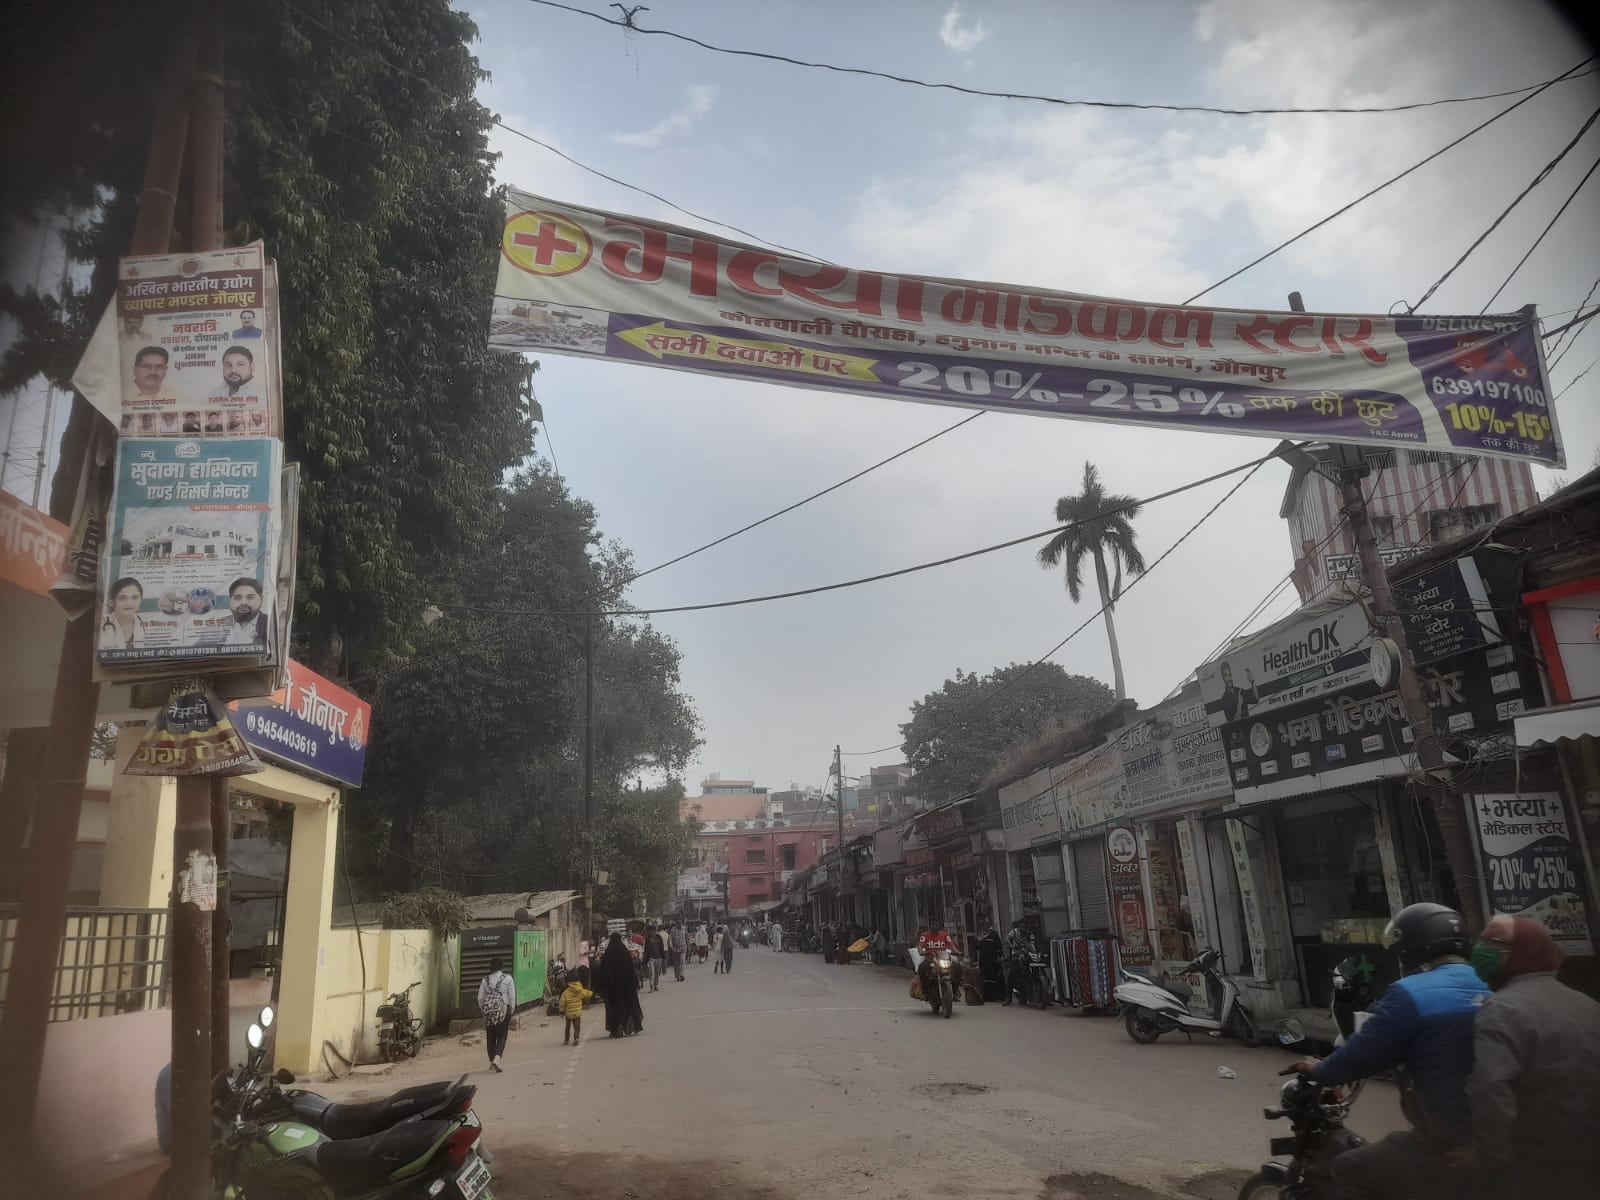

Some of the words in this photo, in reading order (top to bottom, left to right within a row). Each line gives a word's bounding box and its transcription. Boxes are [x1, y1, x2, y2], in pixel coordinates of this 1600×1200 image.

[126, 280, 168, 297] अखिल
[171, 277, 219, 293] भारतीय
[222, 273, 254, 290] उद्योग
[125, 298, 166, 312] व्यापार
[168, 294, 209, 309] मण्डल
[210, 290, 257, 307] जौनपुर
[172, 319, 218, 333] नवरात्रि
[644, 333, 711, 355] सभी
[717, 342, 805, 368] दवाओं
[812, 354, 849, 376] पर
[719, 310, 835, 336] कोतवाली
[935, 335, 1017, 352] हनुमान
[1099, 349, 1121, 361] के
[1210, 357, 1288, 383] जौनपुर
[897, 361, 1246, 419] 20%-25%
[1244, 394, 1298, 412] तक
[1305, 390, 1344, 417] की
[1481, 436, 1502, 448] तक
[1504, 437, 1520, 450] की
[130, 462, 187, 485] सुदामा
[189, 457, 259, 479] हास्पिटल
[147, 484, 174, 500] एण्ड
[212, 481, 250, 499] सेन्टर
[1412, 585, 1440, 606] भव्या
[1263, 619, 1340, 673] HealthOK
[1276, 656, 1316, 678] MULTIVITAMIN
[1316, 647, 1343, 664] TABLETS
[299, 682, 349, 746] जौनपुर
[1278, 712, 1323, 747] भव्या
[1321, 690, 1409, 736] मेडिकल
[257, 715, 318, 758] 9454403619
[1491, 798, 1547, 818] भव्या
[1482, 821, 1533, 836] मेडिकल
[1535, 819, 1566, 835] स्टोर
[1112, 863, 1138, 873] डाबर
[1489, 855, 1577, 891] 20%-25%
